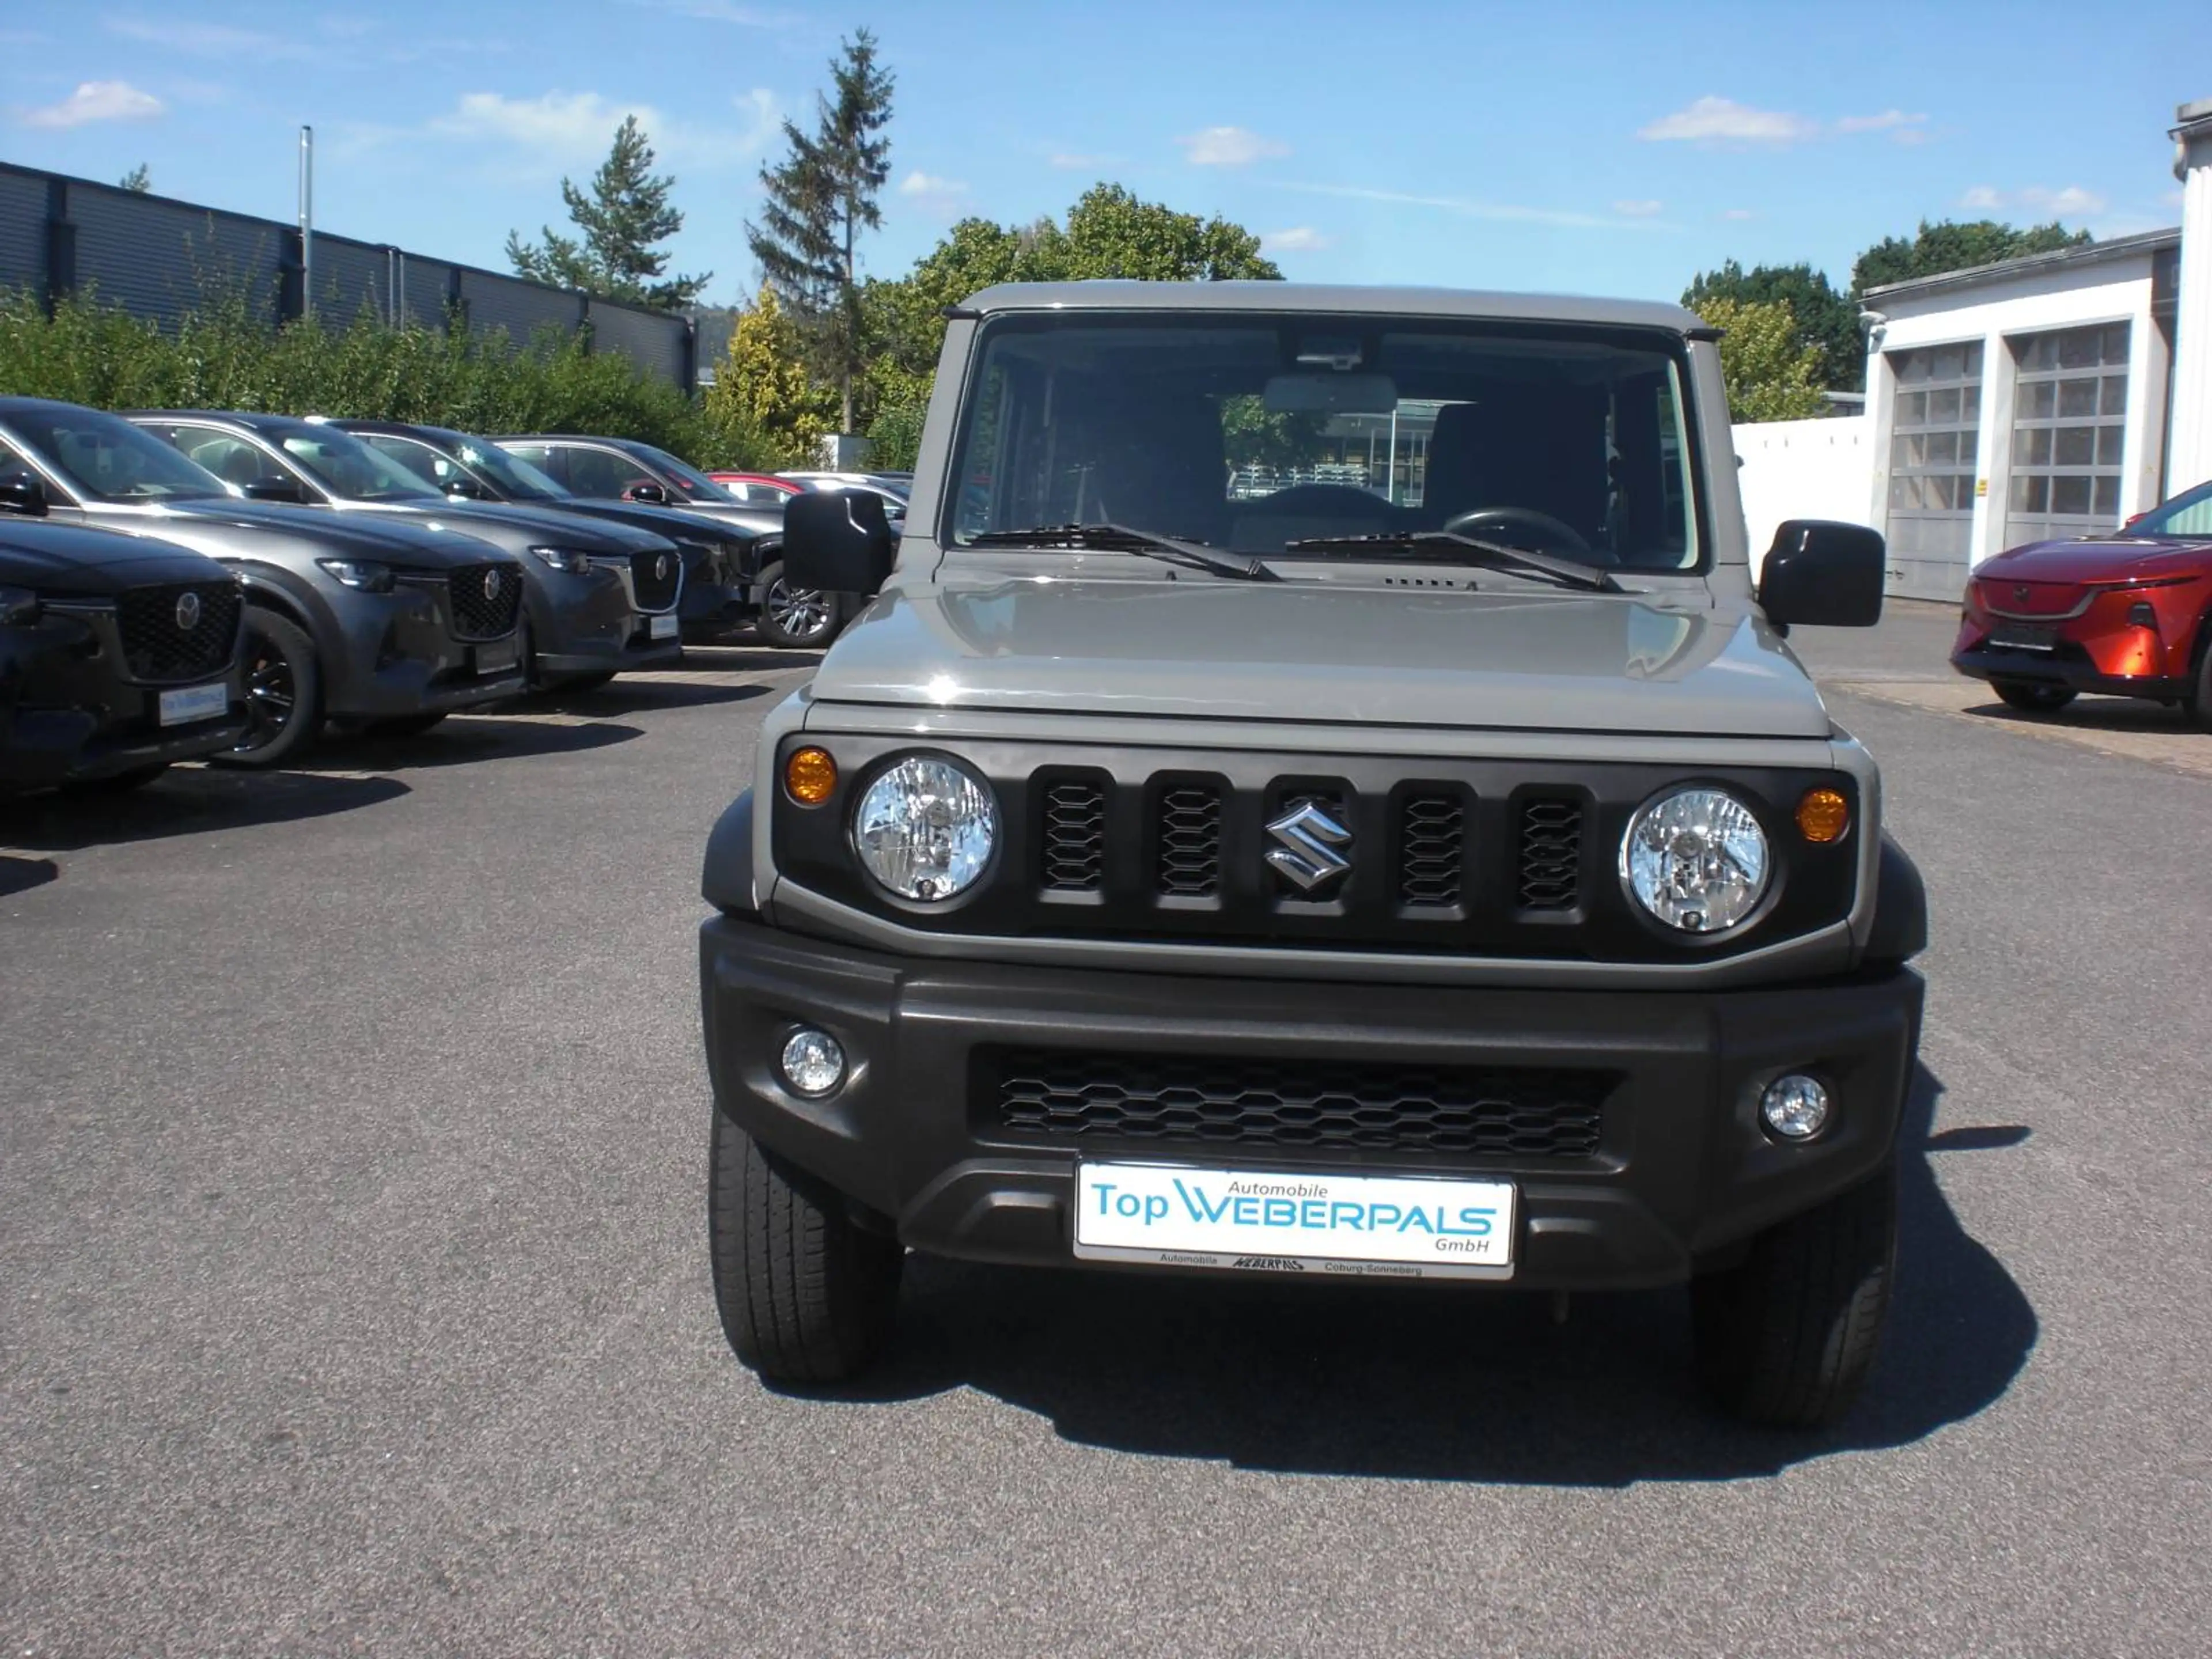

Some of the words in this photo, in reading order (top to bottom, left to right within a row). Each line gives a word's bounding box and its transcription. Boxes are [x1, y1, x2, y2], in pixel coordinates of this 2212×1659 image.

[1228, 1181, 1328, 1198] Automobile
[1090, 1183, 1169, 1225] Top
[1172, 1178, 1497, 1236] WEBERPALS
[1435, 1238, 1490, 1253] GmbH
[1160, 1253, 1218, 1265] Automobile
